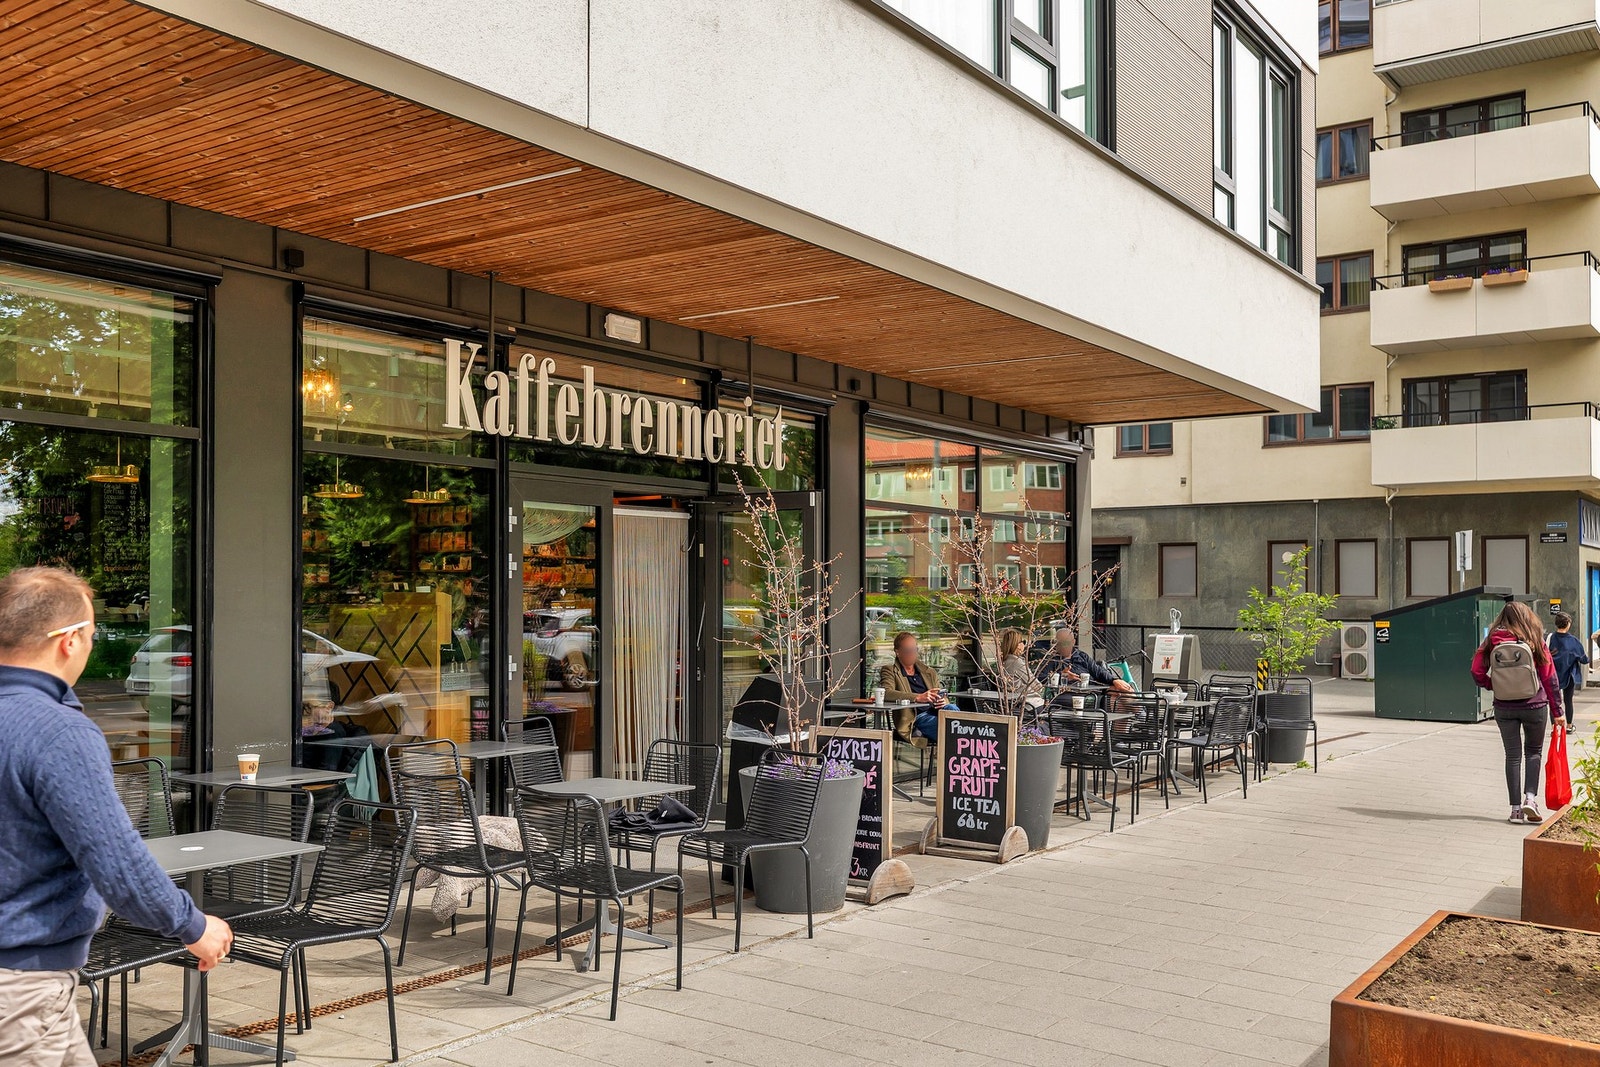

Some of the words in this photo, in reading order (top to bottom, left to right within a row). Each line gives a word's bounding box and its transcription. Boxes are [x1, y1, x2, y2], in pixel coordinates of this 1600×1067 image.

[442, 338, 786, 471] Kaffebrenneriet
[977, 725, 996, 737] VÅR
[827, 739, 882, 762] ISKREM
[957, 738, 999, 759] PINK
[949, 756, 1006, 778] GRAPE-
[949, 775, 999, 798] FRUIT
[953, 797, 971, 811] ICE
[974, 798, 1000, 815] TEA
[957, 813, 975, 828] 68
[977, 819, 989, 830] kr
